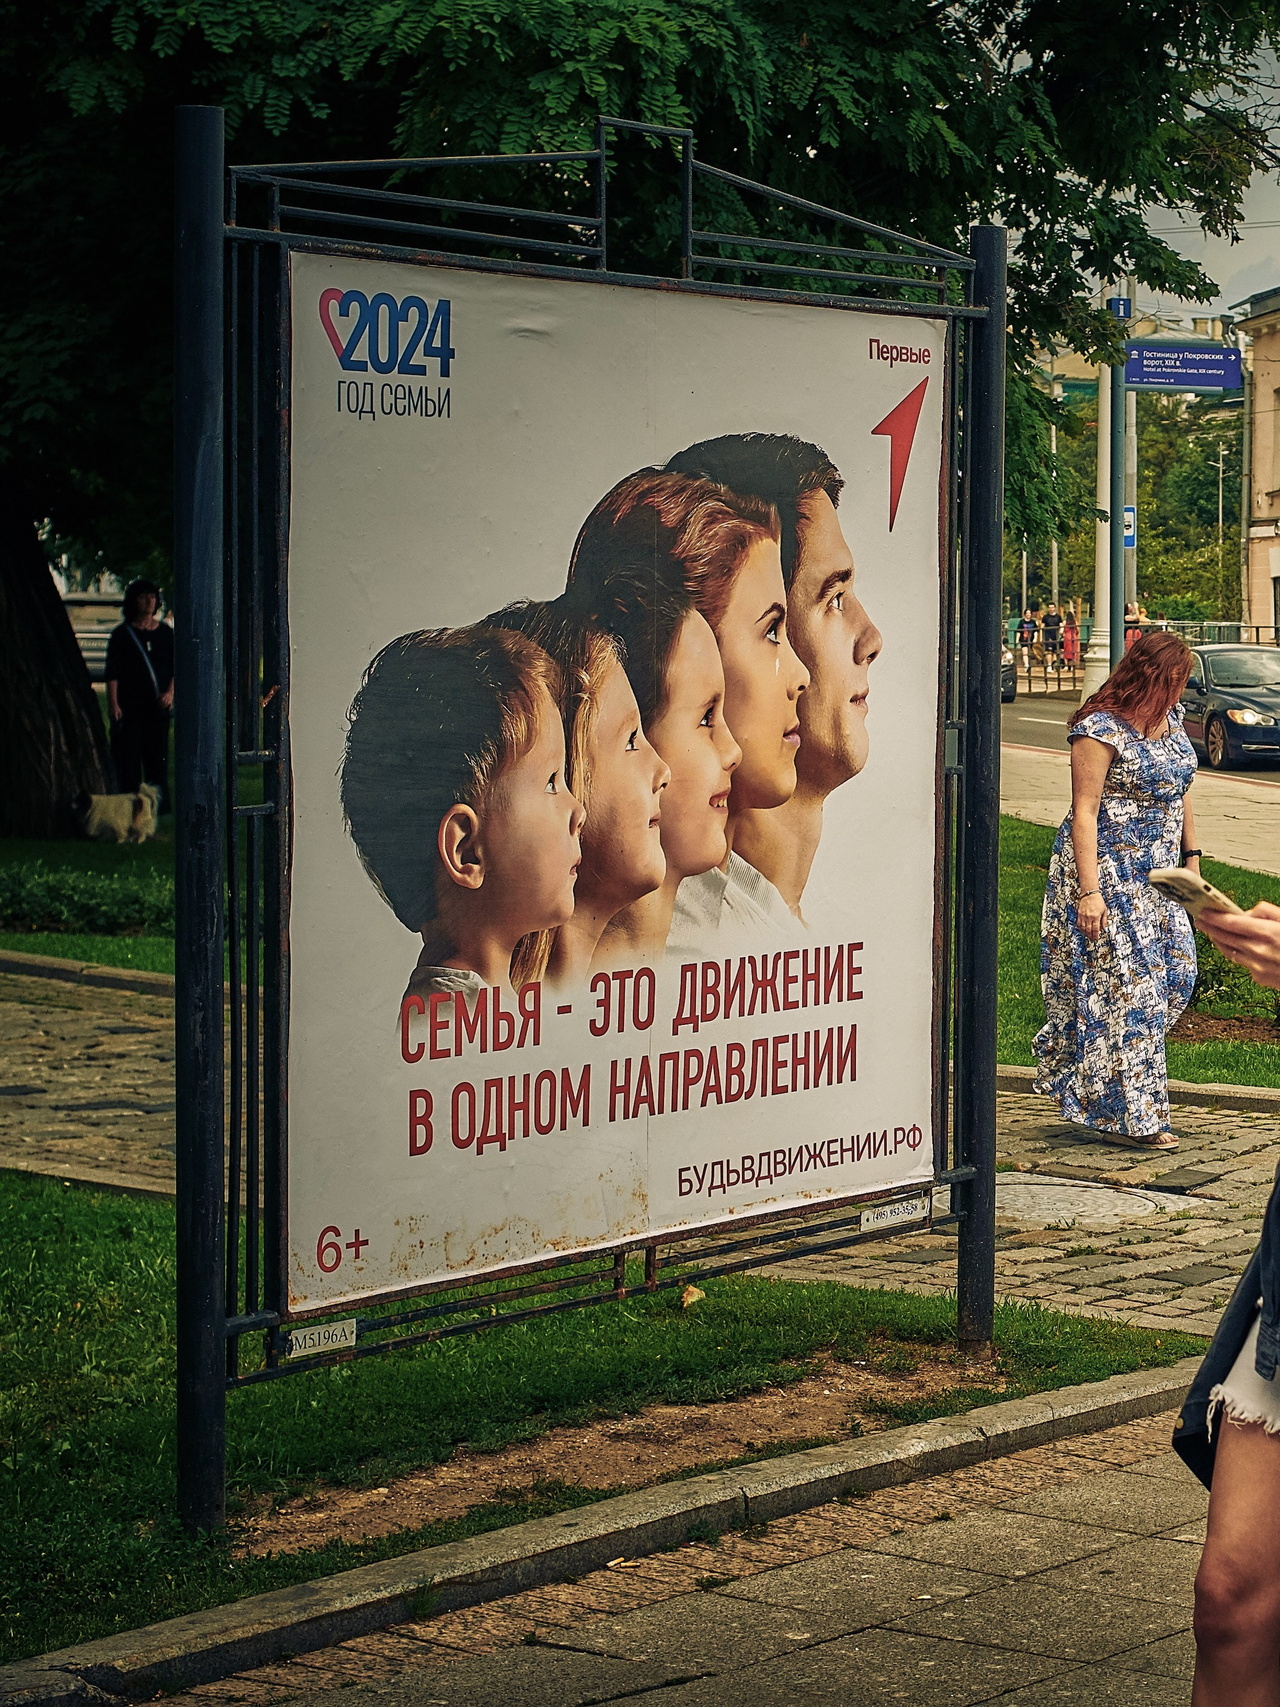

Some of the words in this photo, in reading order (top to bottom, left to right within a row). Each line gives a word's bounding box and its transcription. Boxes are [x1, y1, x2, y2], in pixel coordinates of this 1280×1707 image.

[338, 289, 456, 378] 2024
[868, 338, 931, 368] Первые
[1143, 351, 1178, 359] Гостиница
[1184, 352, 1224, 361] Покровских
[400, 981, 542, 1064] СЕМЬЯ
[588, 966, 657, 1038] ЭТО
[672, 941, 865, 1037] ДВИЖЕНИЕ
[408, 1086, 435, 1157] В
[450, 1062, 592, 1157] ОДНОМ
[608, 1023, 858, 1123] НАПРАВЛЕНИИ
[677, 1123, 923, 1198] БУДЬВДВИЖЕНИИ.РФ
[872, 1210, 889, 1223] (495)
[316, 1225, 370, 1274] 6+
